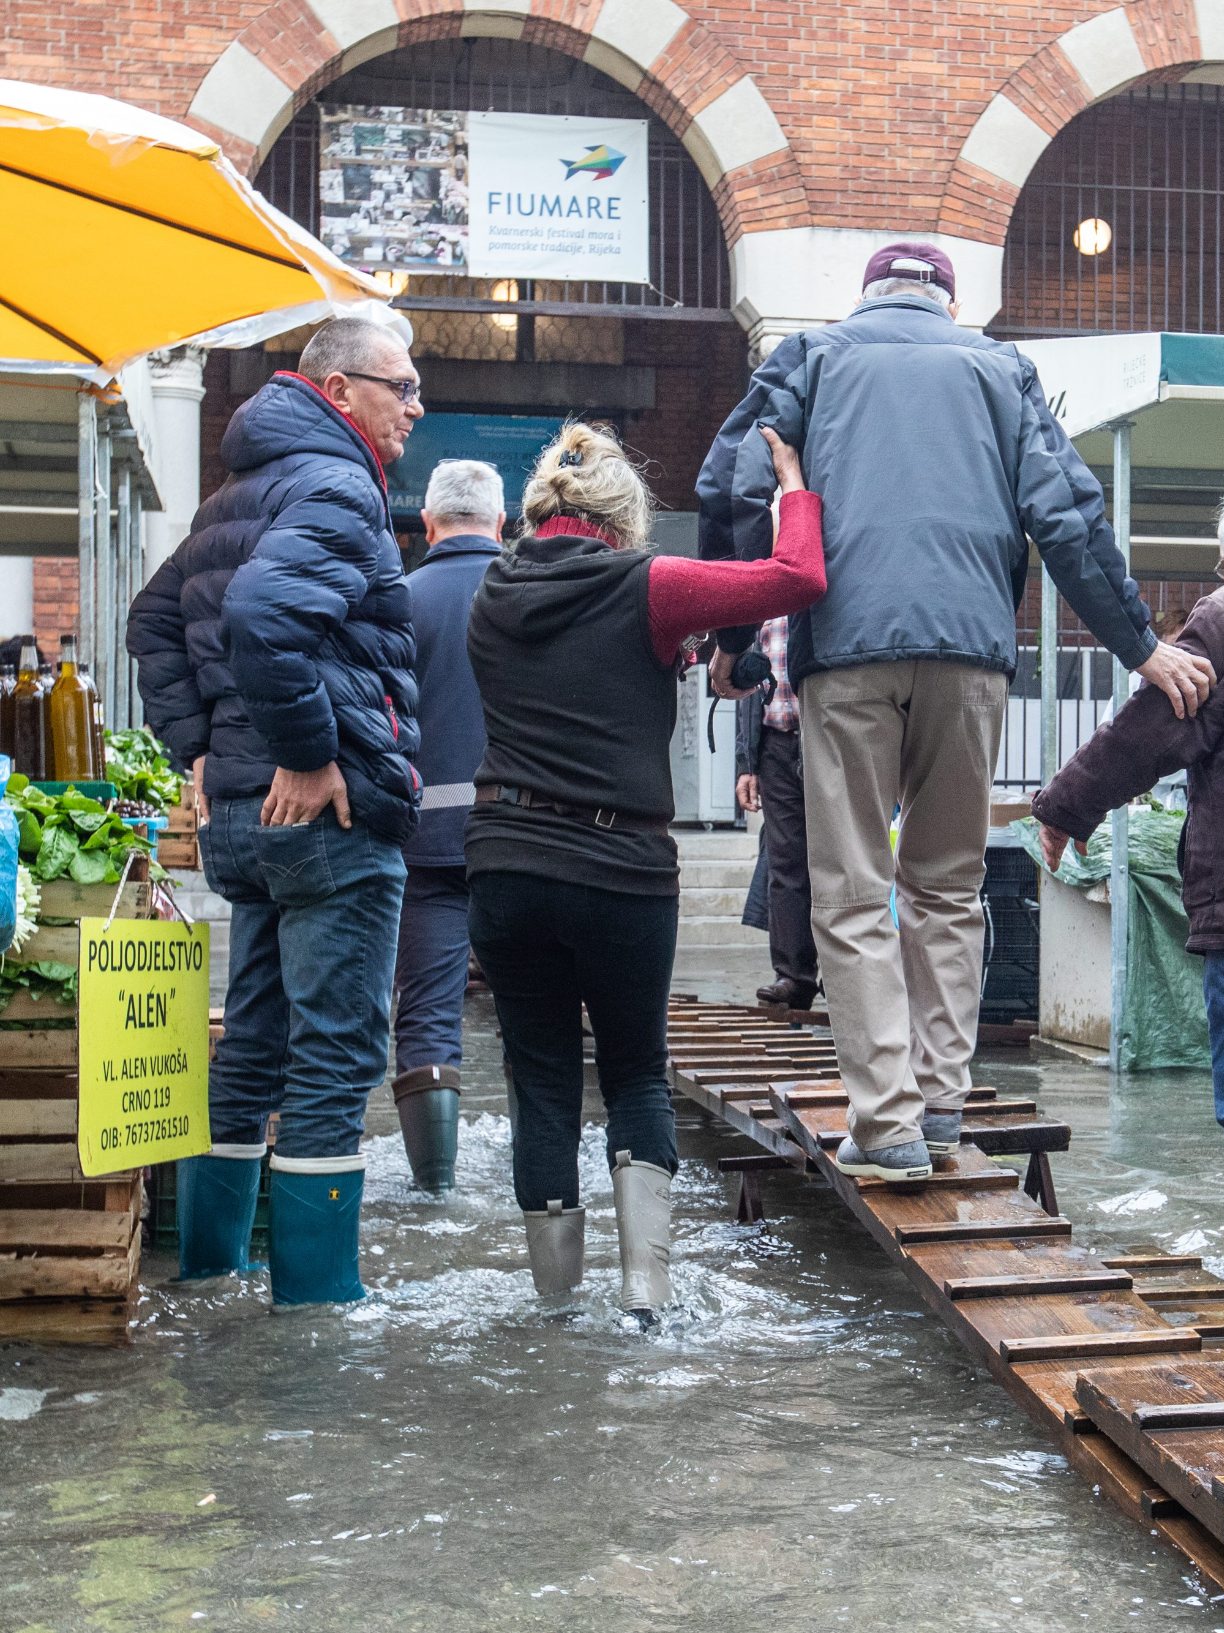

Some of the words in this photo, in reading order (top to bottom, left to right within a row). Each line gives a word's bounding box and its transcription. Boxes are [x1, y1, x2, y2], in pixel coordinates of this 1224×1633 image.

[488, 191, 622, 220] FIUMARE
[488, 225, 543, 238] Kvarnerski
[547, 227, 585, 240] festival
[588, 231, 615, 240] mora
[488, 241, 538, 252] pomorske
[588, 244, 621, 256] Rijeka
[88, 939, 203, 972] POLJODJELSTVO
[103, 1060, 118, 1083] VL.
[121, 1057, 147, 1080] ALEN
[150, 1048, 188, 1077] VUKOŠA
[122, 1090, 150, 1113] CRNO
[153, 1086, 171, 1109] 119
[101, 1127, 122, 1151] OIB:
[125, 1114, 189, 1147] 76737261510
